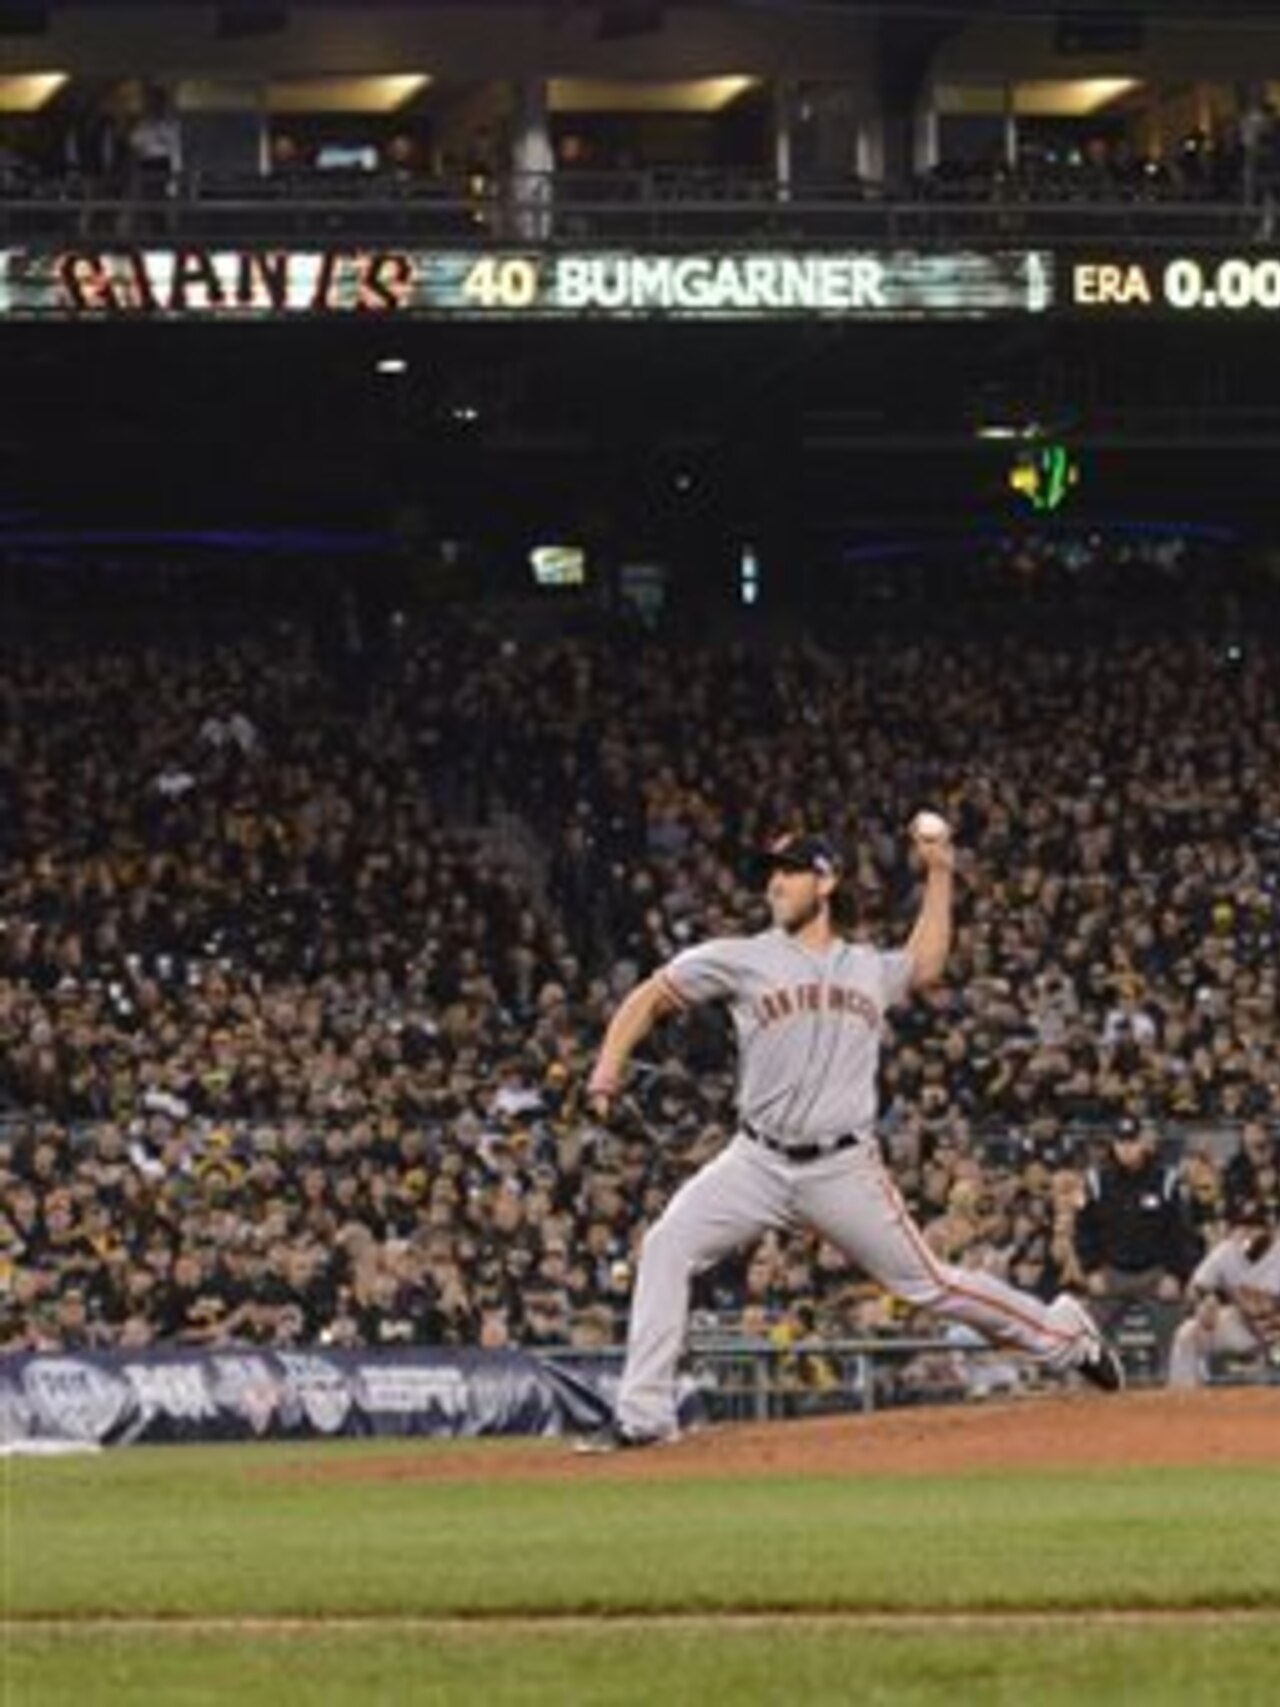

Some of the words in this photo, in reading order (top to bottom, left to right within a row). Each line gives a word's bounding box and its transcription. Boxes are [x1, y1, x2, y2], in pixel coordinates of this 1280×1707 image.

[462, 257, 536, 307] 40
[555, 258, 886, 308] BUMGARNER
[1073, 265, 1151, 304] ERA
